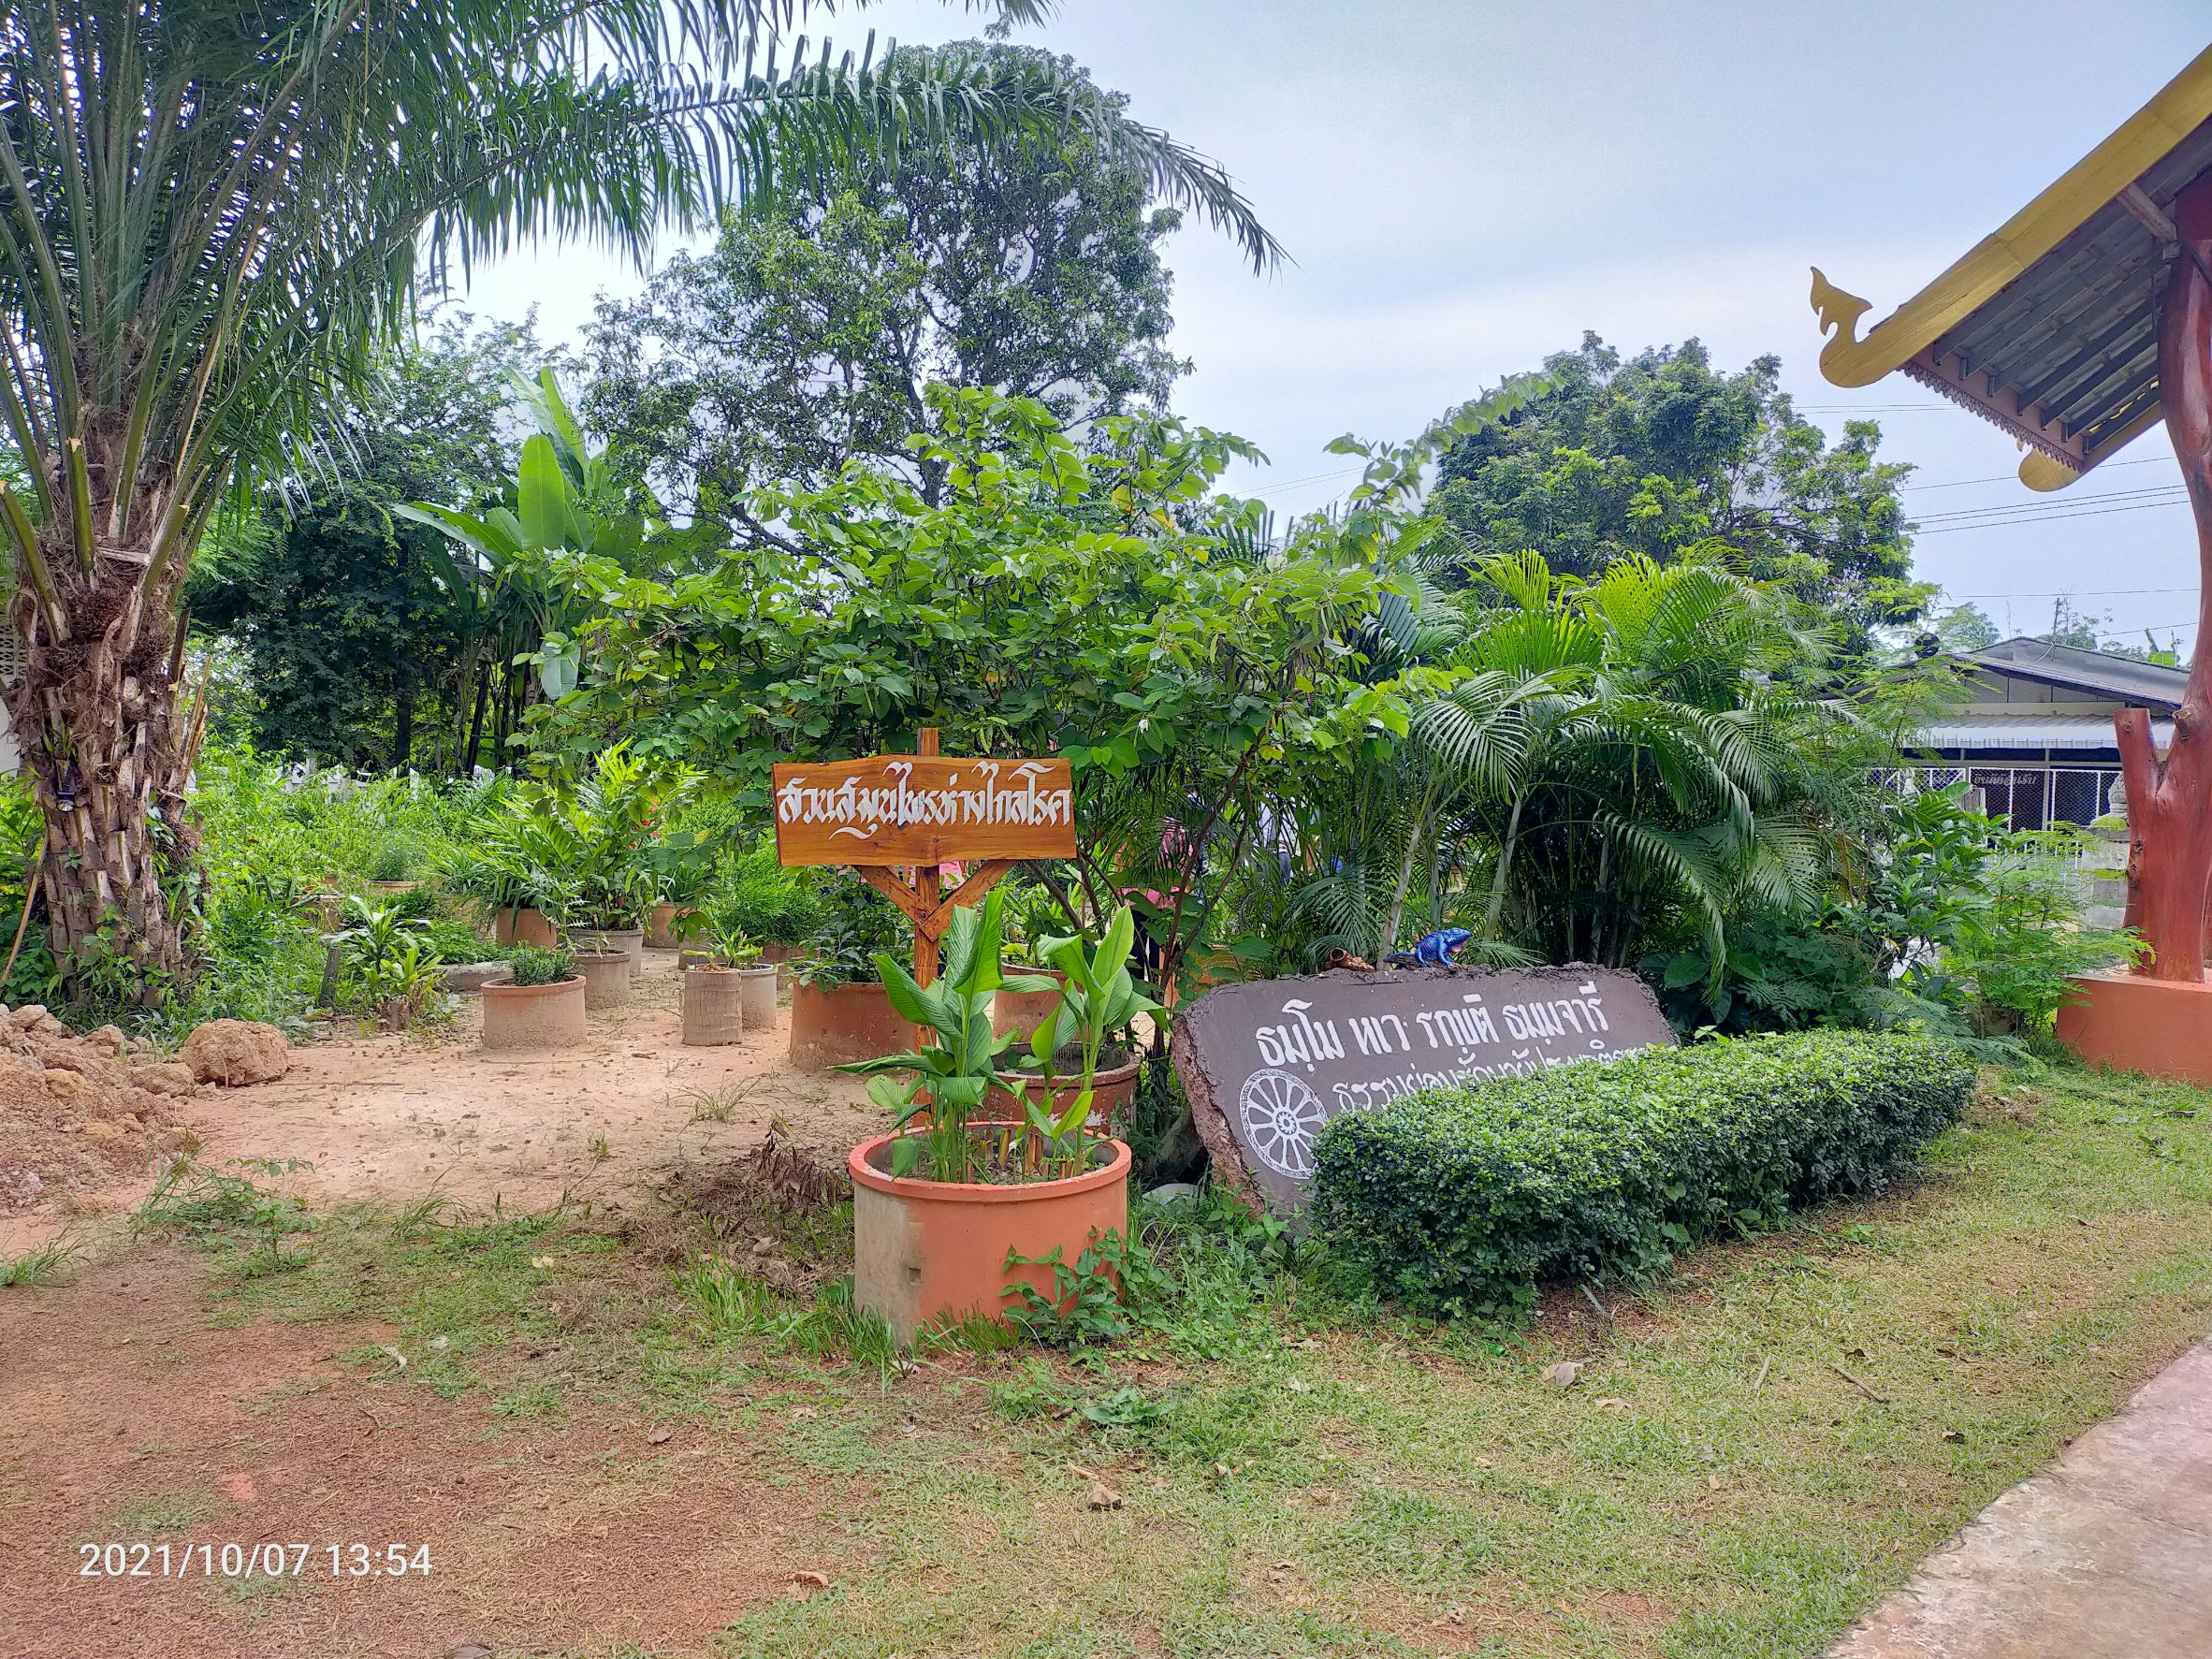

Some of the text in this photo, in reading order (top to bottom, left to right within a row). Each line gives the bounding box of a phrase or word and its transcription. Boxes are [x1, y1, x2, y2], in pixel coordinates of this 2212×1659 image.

[777, 761, 1072, 840] สวนสมุนไพรห่างไกลโรค
